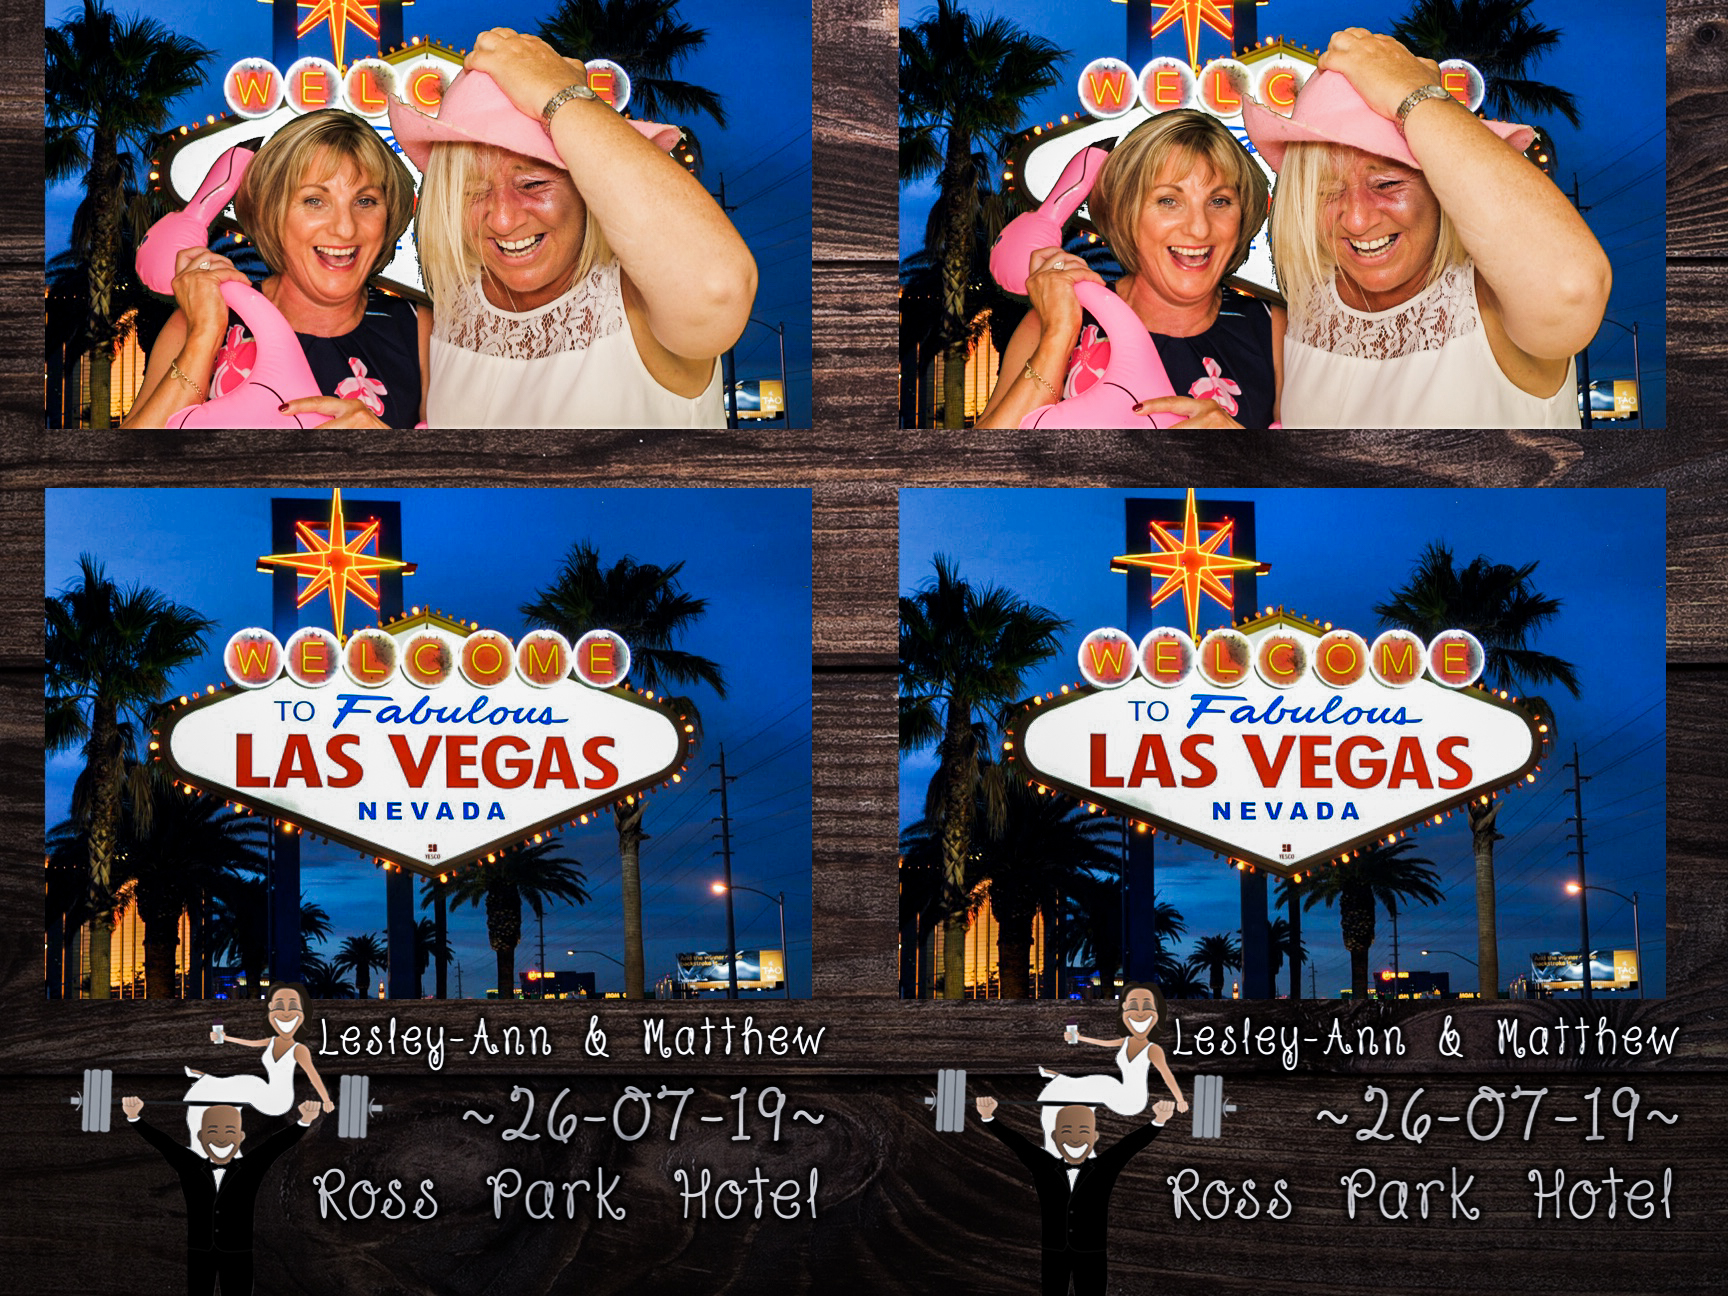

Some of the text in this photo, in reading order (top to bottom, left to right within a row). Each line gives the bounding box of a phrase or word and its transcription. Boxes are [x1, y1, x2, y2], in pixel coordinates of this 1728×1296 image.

[233, 639, 614, 677] WELCOME
[1087, 639, 1468, 677] WELCOME
[273, 693, 569, 729] TO Fabulous
[1127, 693, 1423, 729] TO Fabulous
[235, 733, 619, 790] LAS VEGAS
[1089, 733, 1473, 790] LAS VEGAS
[358, 801, 506, 821] NEVADA
[1212, 801, 1360, 821] NEVADA
